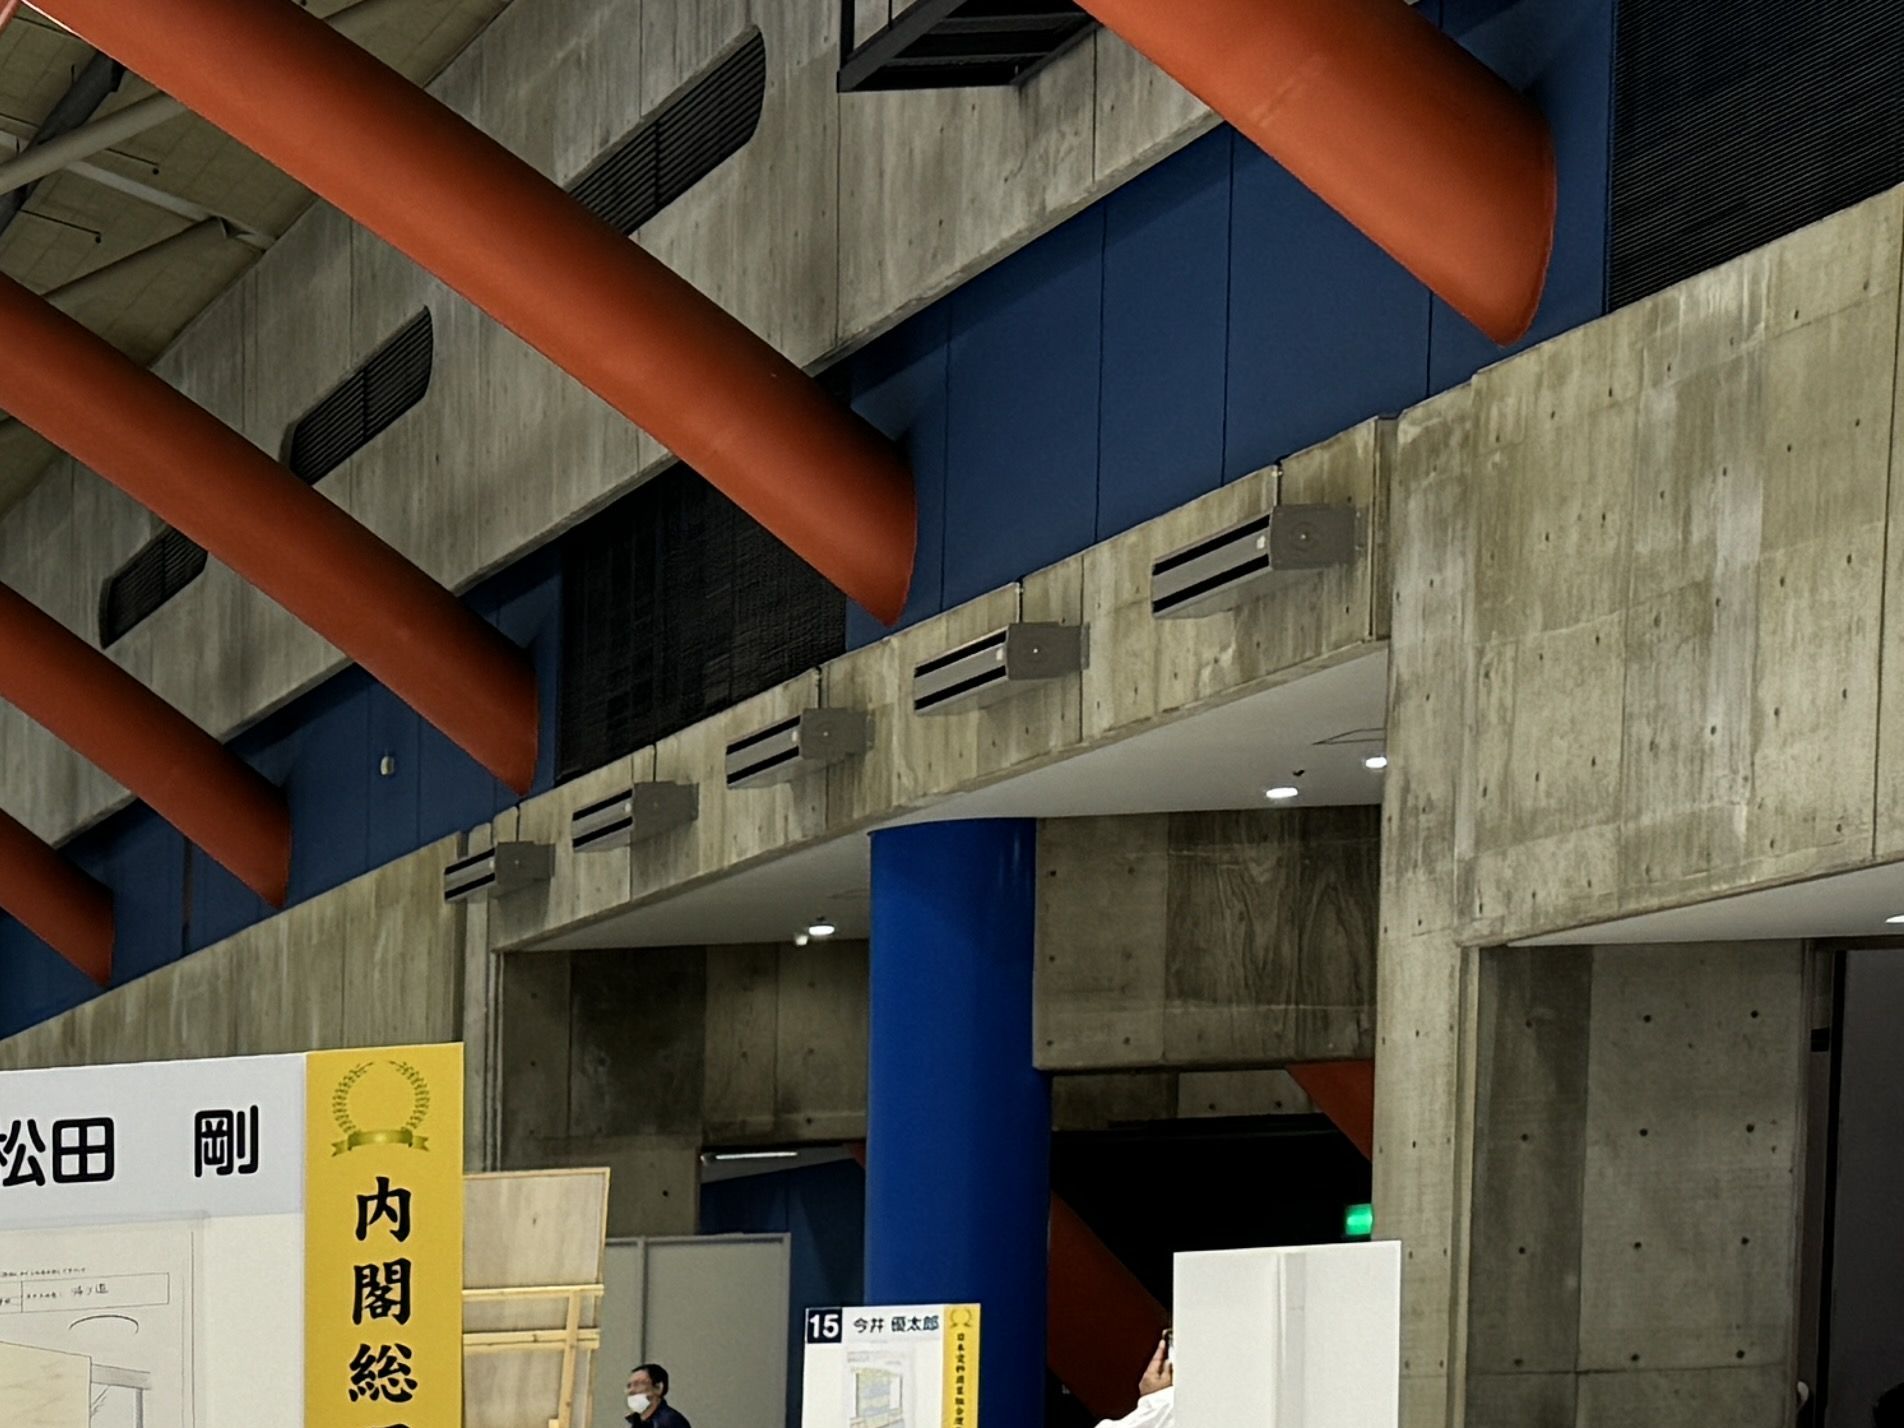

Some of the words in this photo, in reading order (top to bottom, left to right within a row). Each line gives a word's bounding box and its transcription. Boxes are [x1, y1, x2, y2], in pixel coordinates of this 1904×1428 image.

[194, 1105, 259, 1177] 剛
[809, 1313, 839, 1338] 15
[853, 1317, 884, 1333] 今井
[891, 1315, 940, 1332] 優太郎
